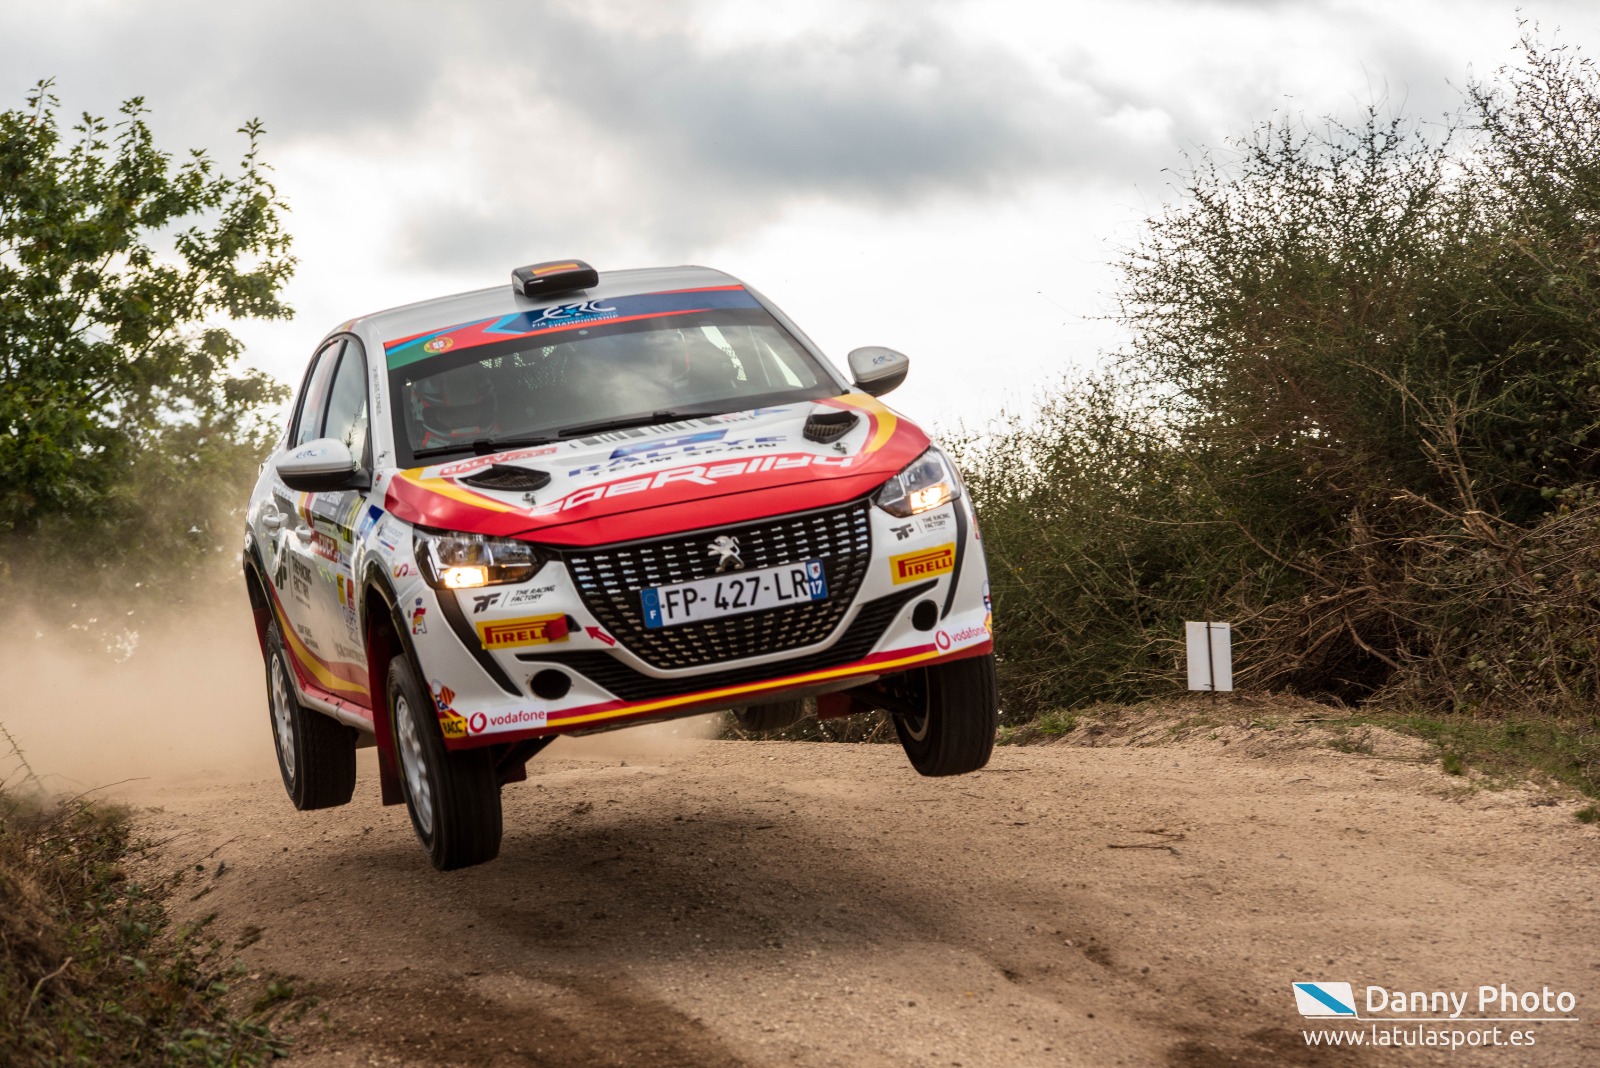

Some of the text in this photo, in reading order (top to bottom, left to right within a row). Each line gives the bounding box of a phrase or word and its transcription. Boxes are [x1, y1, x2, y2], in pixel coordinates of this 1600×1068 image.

[549, 314, 619, 328] CHAMPIONSHIP
[593, 443, 777, 476] TEAM SPAIN
[897, 549, 953, 578] PIRELLI
[515, 585, 556, 596] THE RACING
[810, 580, 823, 595] 17
[511, 594, 543, 602] FACTORY
[650, 610, 657, 620] F
[950, 624, 987, 643] vodafone
[490, 709, 546, 727] vodafone
